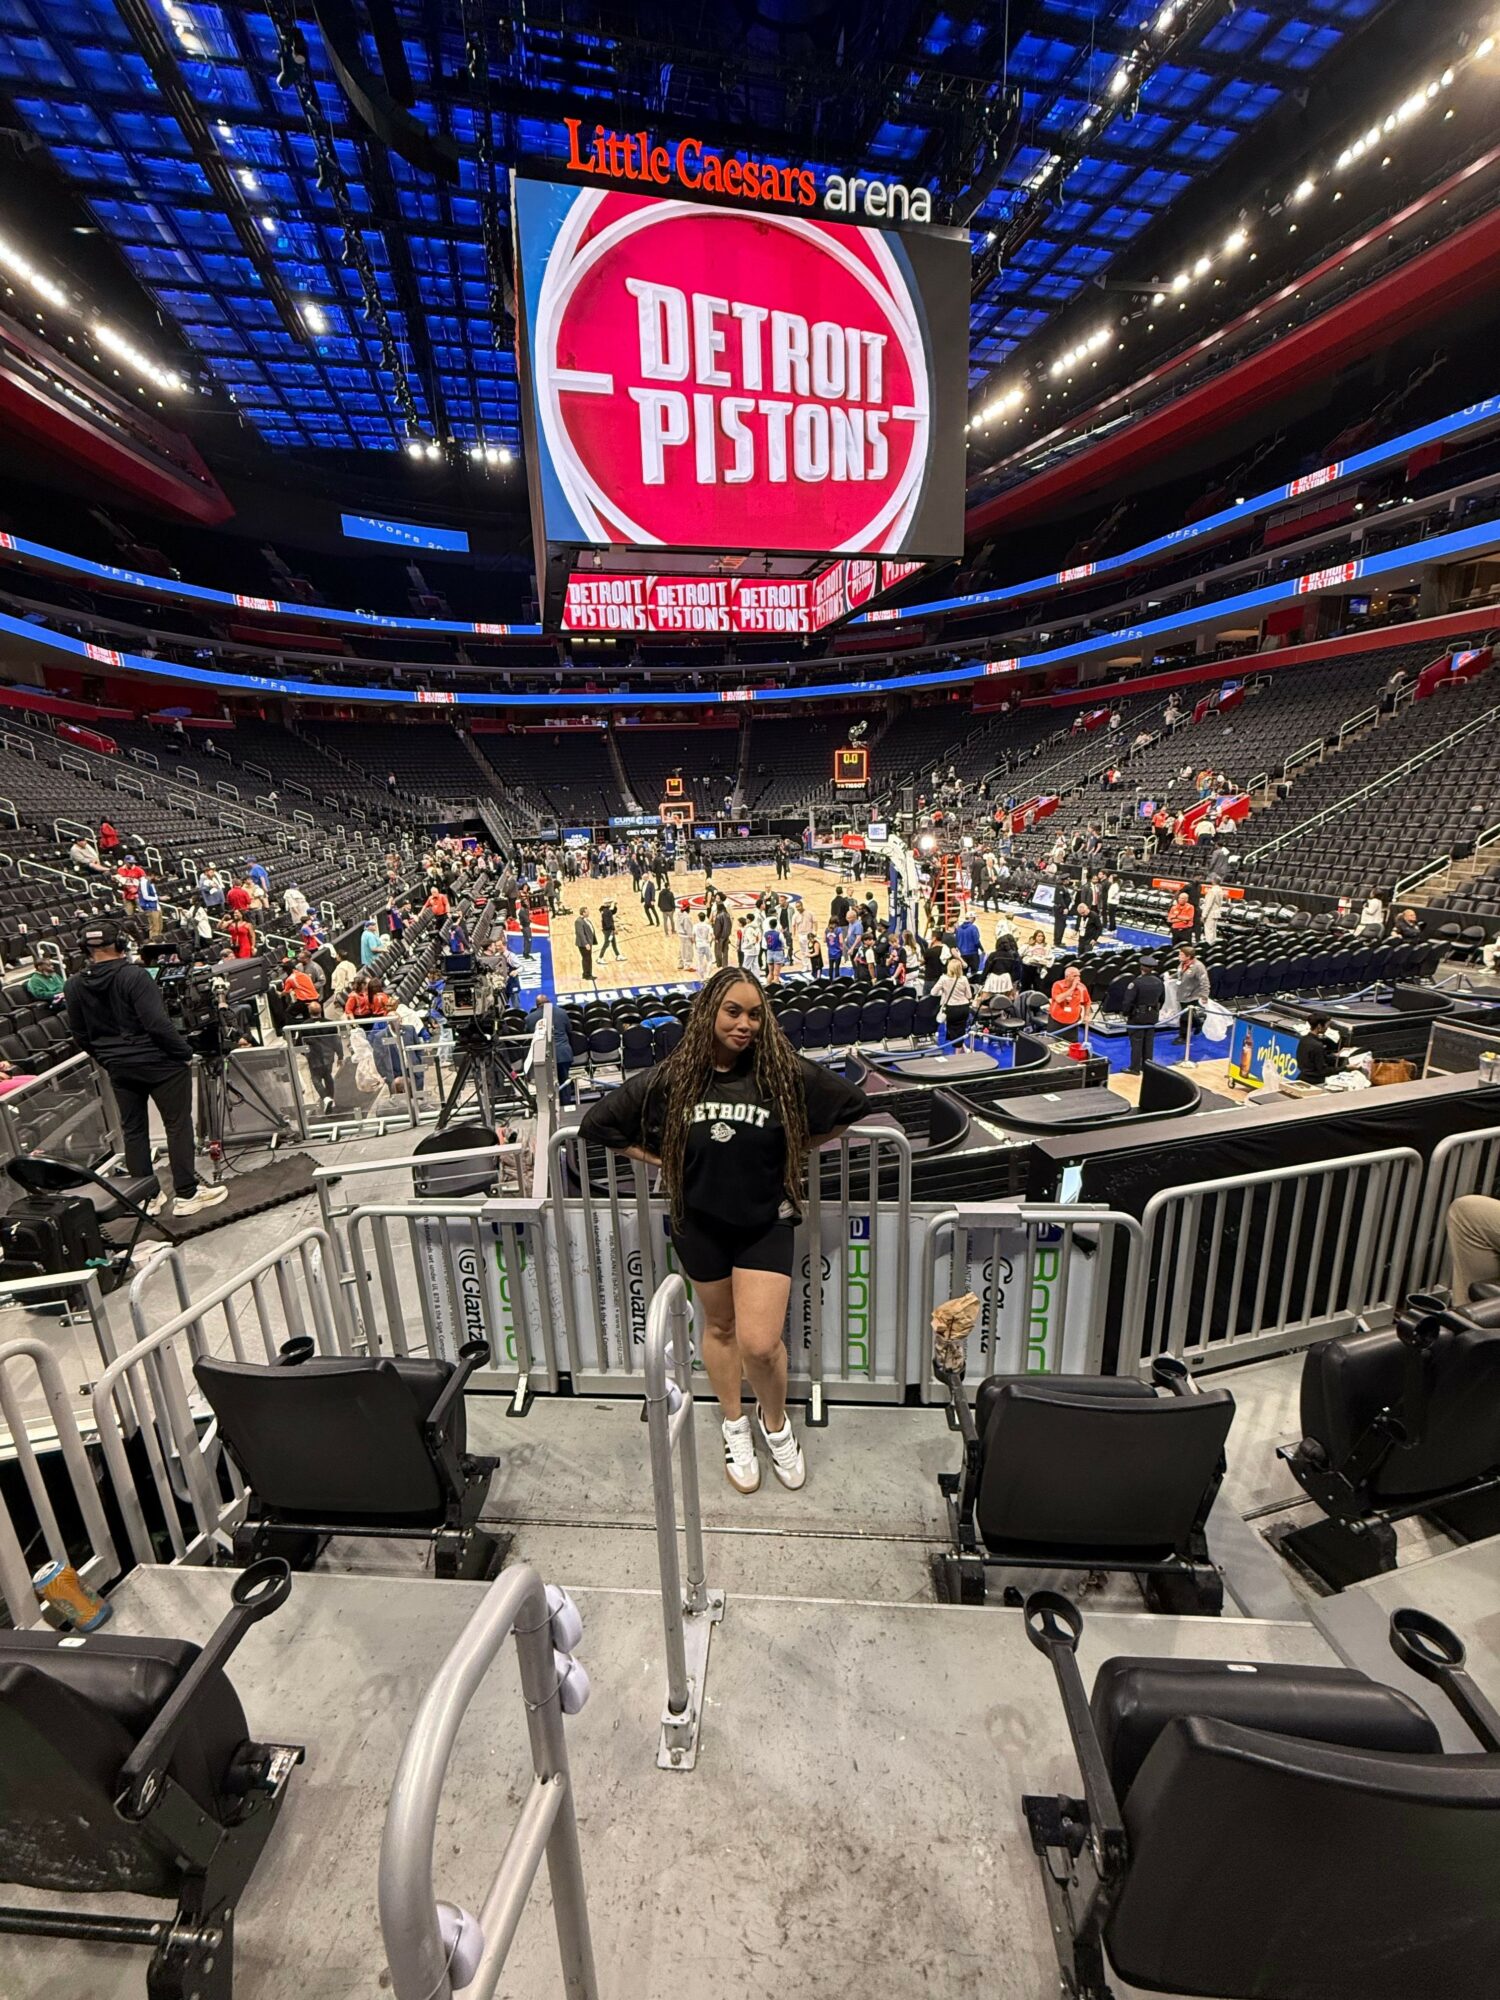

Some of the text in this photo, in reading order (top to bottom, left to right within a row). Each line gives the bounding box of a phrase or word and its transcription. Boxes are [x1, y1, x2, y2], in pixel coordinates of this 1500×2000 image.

[563, 117, 932, 224] Little Caesars arena
[625, 277, 888, 404] DETROIT
[628, 386, 890, 485] PISTONS
[568, 579, 644, 604] DETROIT
[656, 581, 728, 606] DETROIT
[739, 584, 808, 608] DETROIT
[569, 604, 647, 630] PISTONS
[657, 606, 730, 631] PISTONS
[739, 608, 810, 632] PISTONS
[843, 753, 858, 764] 0.0
[1256, 1035, 1298, 1076] milagro
[436, 1321, 444, 1334] Sign
